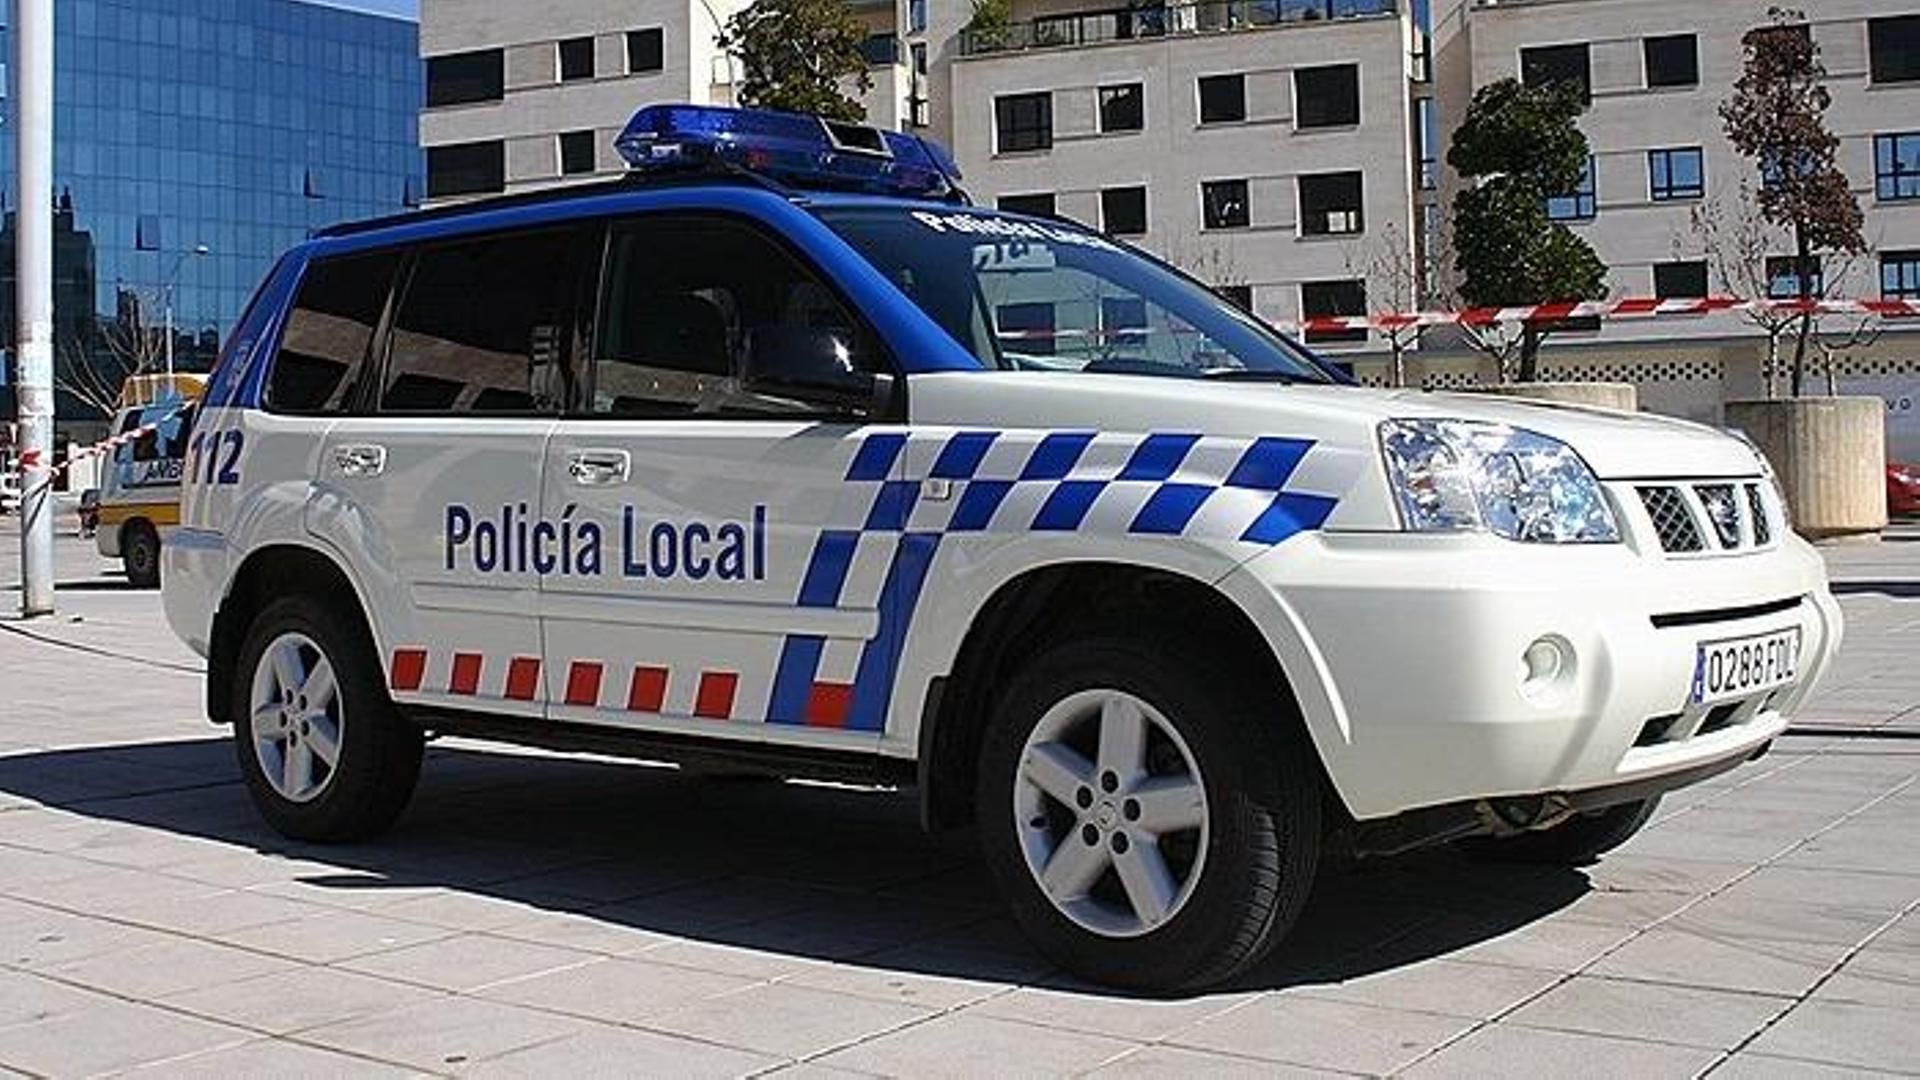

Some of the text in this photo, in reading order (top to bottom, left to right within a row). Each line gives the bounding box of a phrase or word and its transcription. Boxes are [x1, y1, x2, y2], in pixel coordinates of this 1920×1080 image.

[143, 459, 184, 480] AMB
[190, 429, 244, 484] 112
[446, 503, 766, 580] Policía Local
